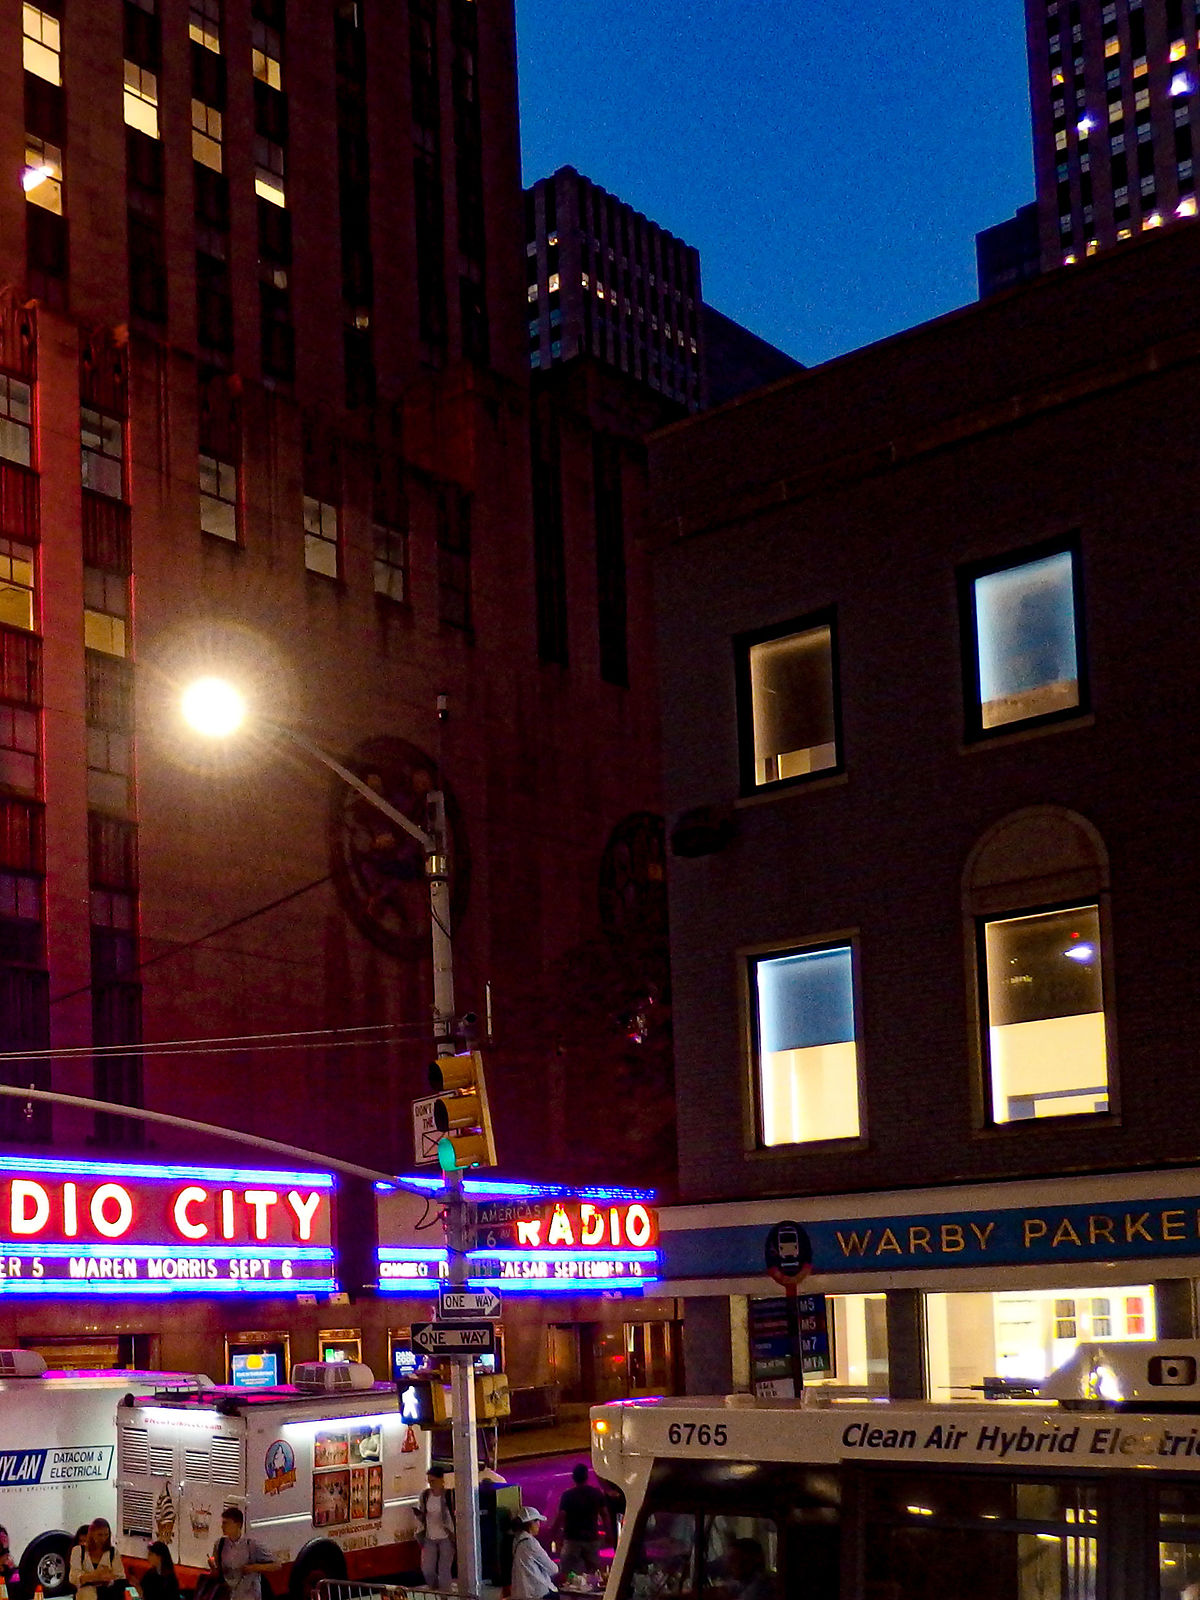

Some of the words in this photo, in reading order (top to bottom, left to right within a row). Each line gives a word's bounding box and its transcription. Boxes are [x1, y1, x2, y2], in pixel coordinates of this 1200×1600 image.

[173, 1186, 320, 1241] CITY
[481, 1205, 540, 1223] AMERICAS
[836, 1222, 995, 1257] WARBY
[1023, 1208, 1200, 1249] PARKE
[32, 1257, 44, 1277] 5
[69, 1258, 137, 1278] MAREN
[148, 1259, 218, 1278] MORRIS
[229, 1260, 271, 1278] SEPT
[281, 1260, 293, 1278] 6
[555, 1261, 624, 1278] SEPTEMBER
[445, 1295, 465, 1308] ONE
[475, 1295, 494, 1307] WAY
[420, 1332, 446, 1344] ONE
[460, 1332, 486, 1344] WAY
[668, 1423, 728, 1446] 6765
[842, 1423, 916, 1448] Clean
[924, 1424, 968, 1450] Air
[976, 1426, 1080, 1457] Hybrid
[1089, 1427, 1200, 1456] Eletri
[53, 1452, 94, 1464] DATACOM
[97, 1451, 103, 1462] &
[50, 1465, 102, 1479] ELECTRICAL
